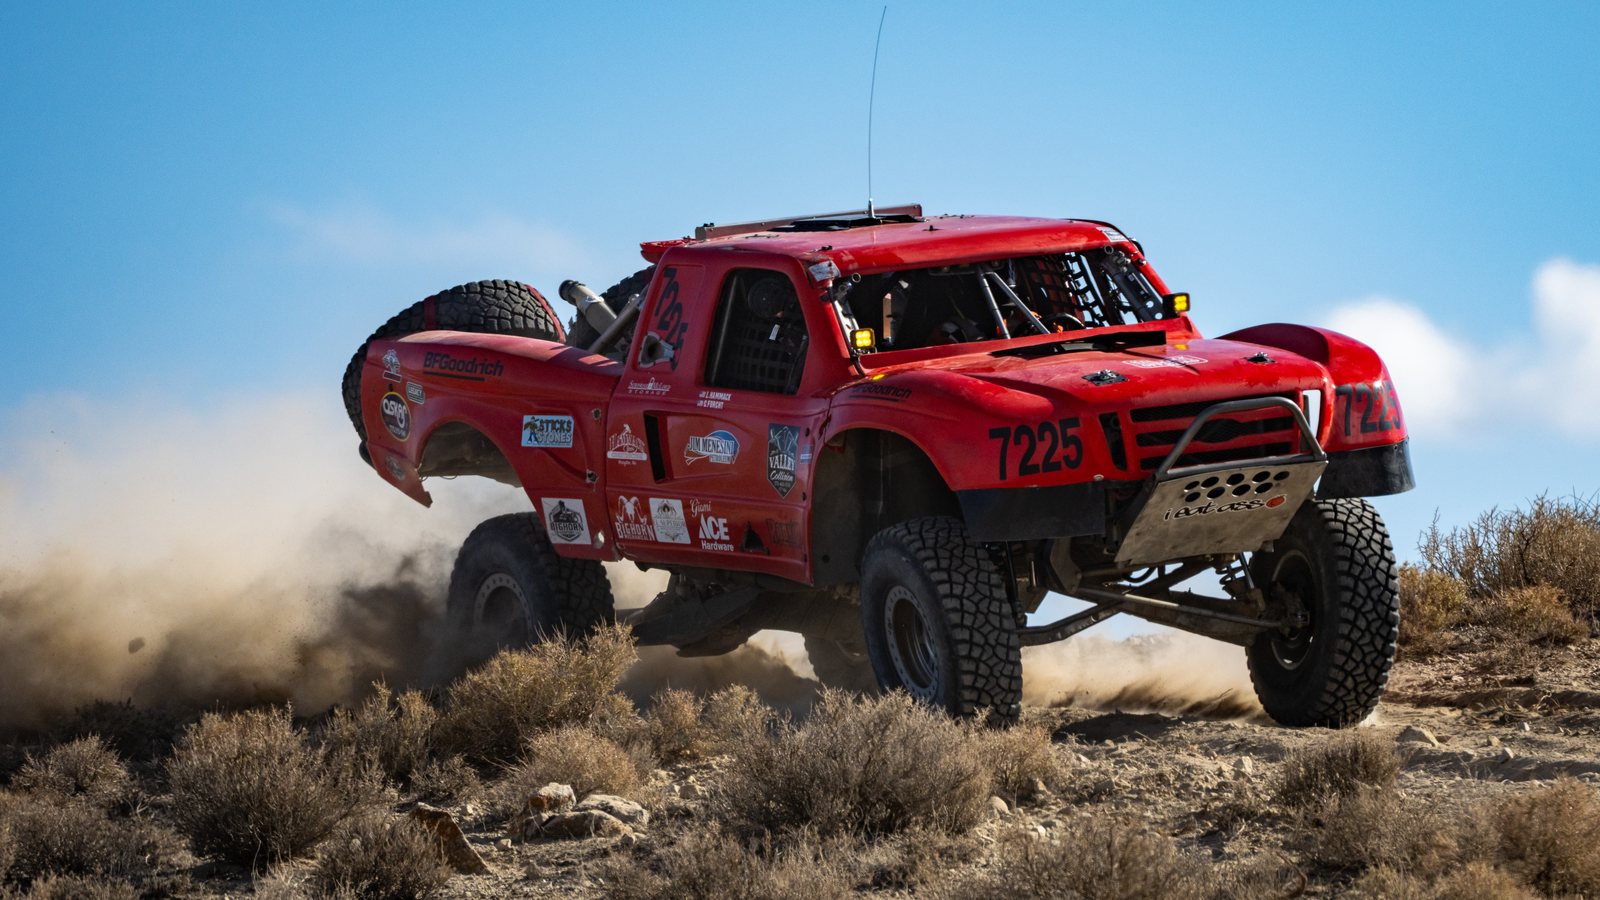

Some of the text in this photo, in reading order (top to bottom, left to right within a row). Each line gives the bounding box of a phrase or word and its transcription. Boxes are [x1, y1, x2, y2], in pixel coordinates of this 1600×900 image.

[423, 351, 504, 377] BFGoodrich
[1335, 381, 1402, 437] 7225
[537, 418, 573, 433] STICKS
[536, 432, 572, 443] STONES
[688, 436, 701, 451] JIM
[989, 416, 1083, 481] 7225
[769, 453, 795, 471] VALLEY
[770, 470, 794, 482] Collision
[615, 521, 656, 541] BIGHORN
[699, 513, 730, 541] ACE
[701, 540, 734, 552] Hardware
